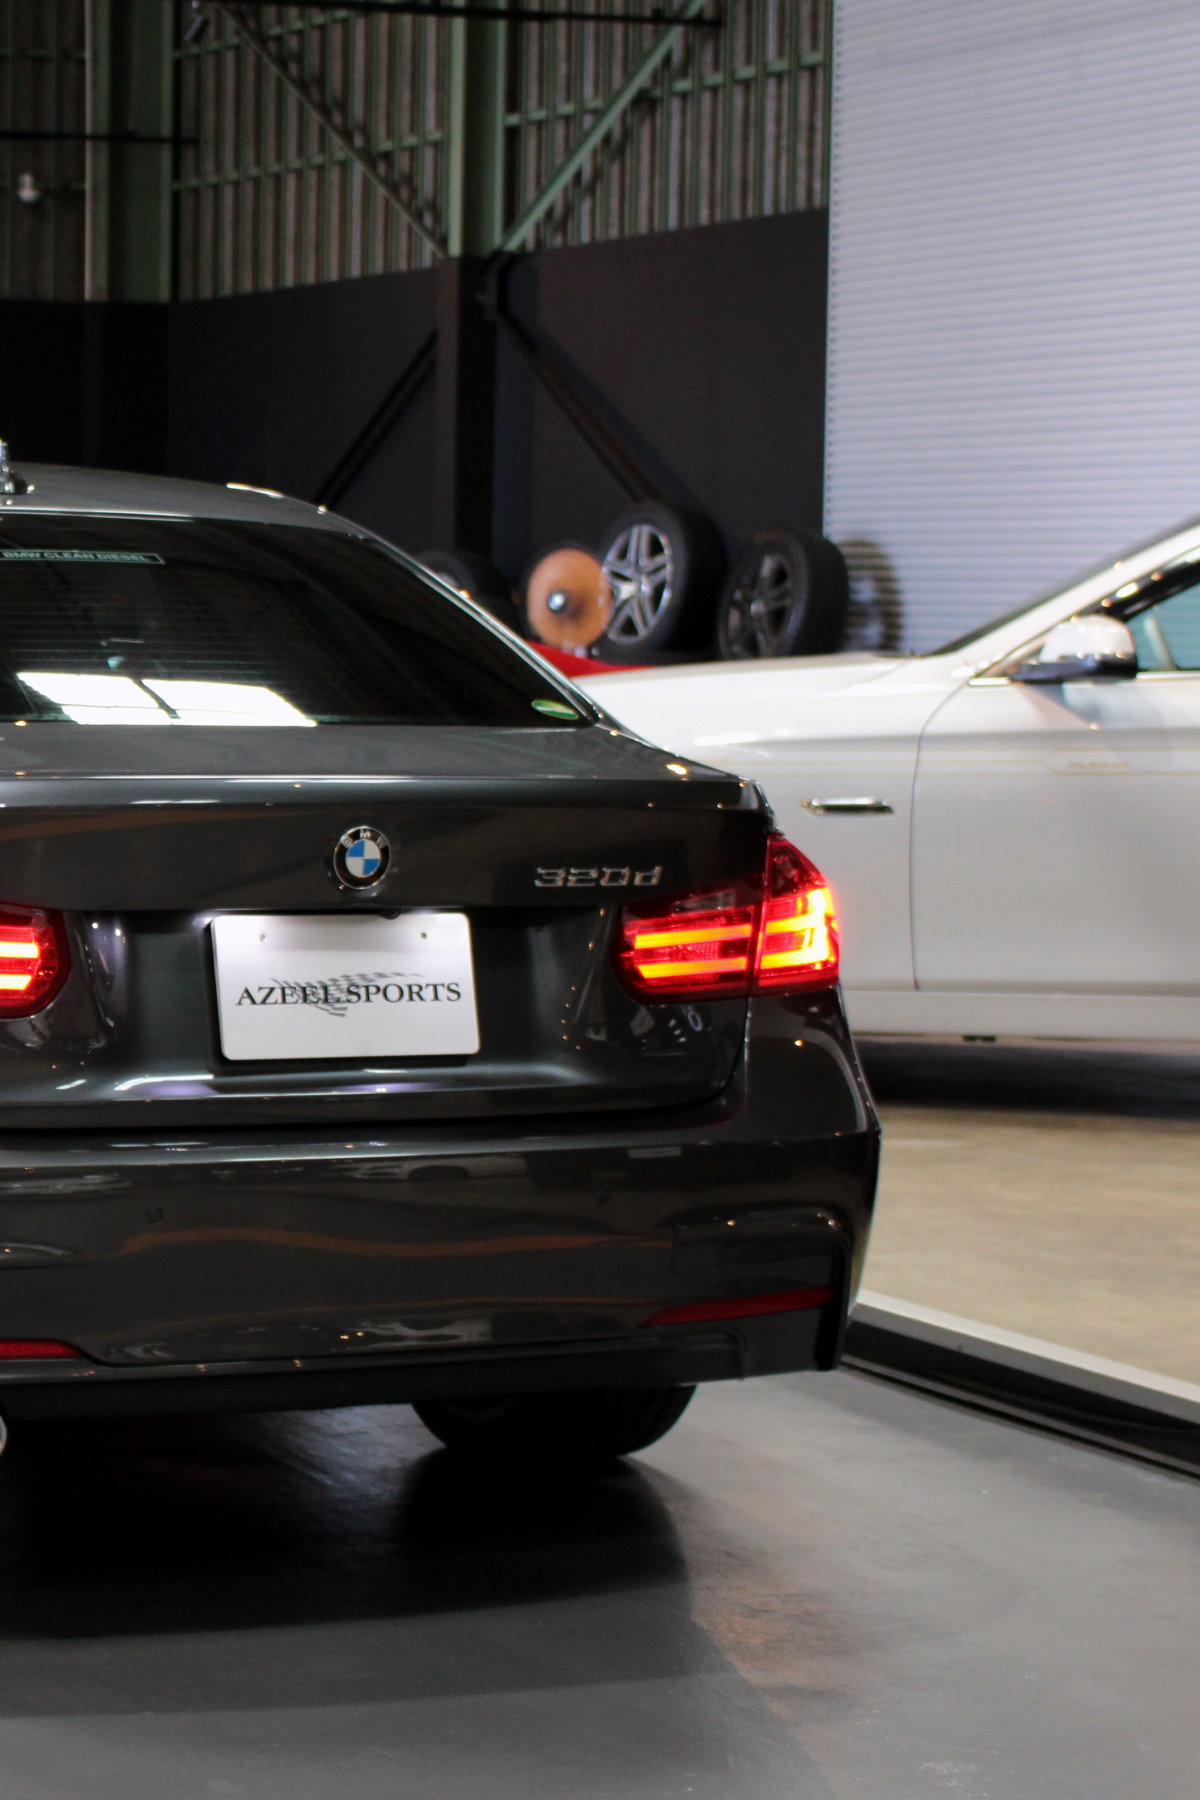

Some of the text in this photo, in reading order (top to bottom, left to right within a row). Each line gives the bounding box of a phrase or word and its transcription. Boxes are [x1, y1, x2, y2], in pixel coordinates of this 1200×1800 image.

[2, 551, 151, 562] BMW CLEAN DIESEL
[340, 828, 388, 849] BMW
[534, 866, 663, 887] 320d
[346, 982, 461, 1004] SPORTS
